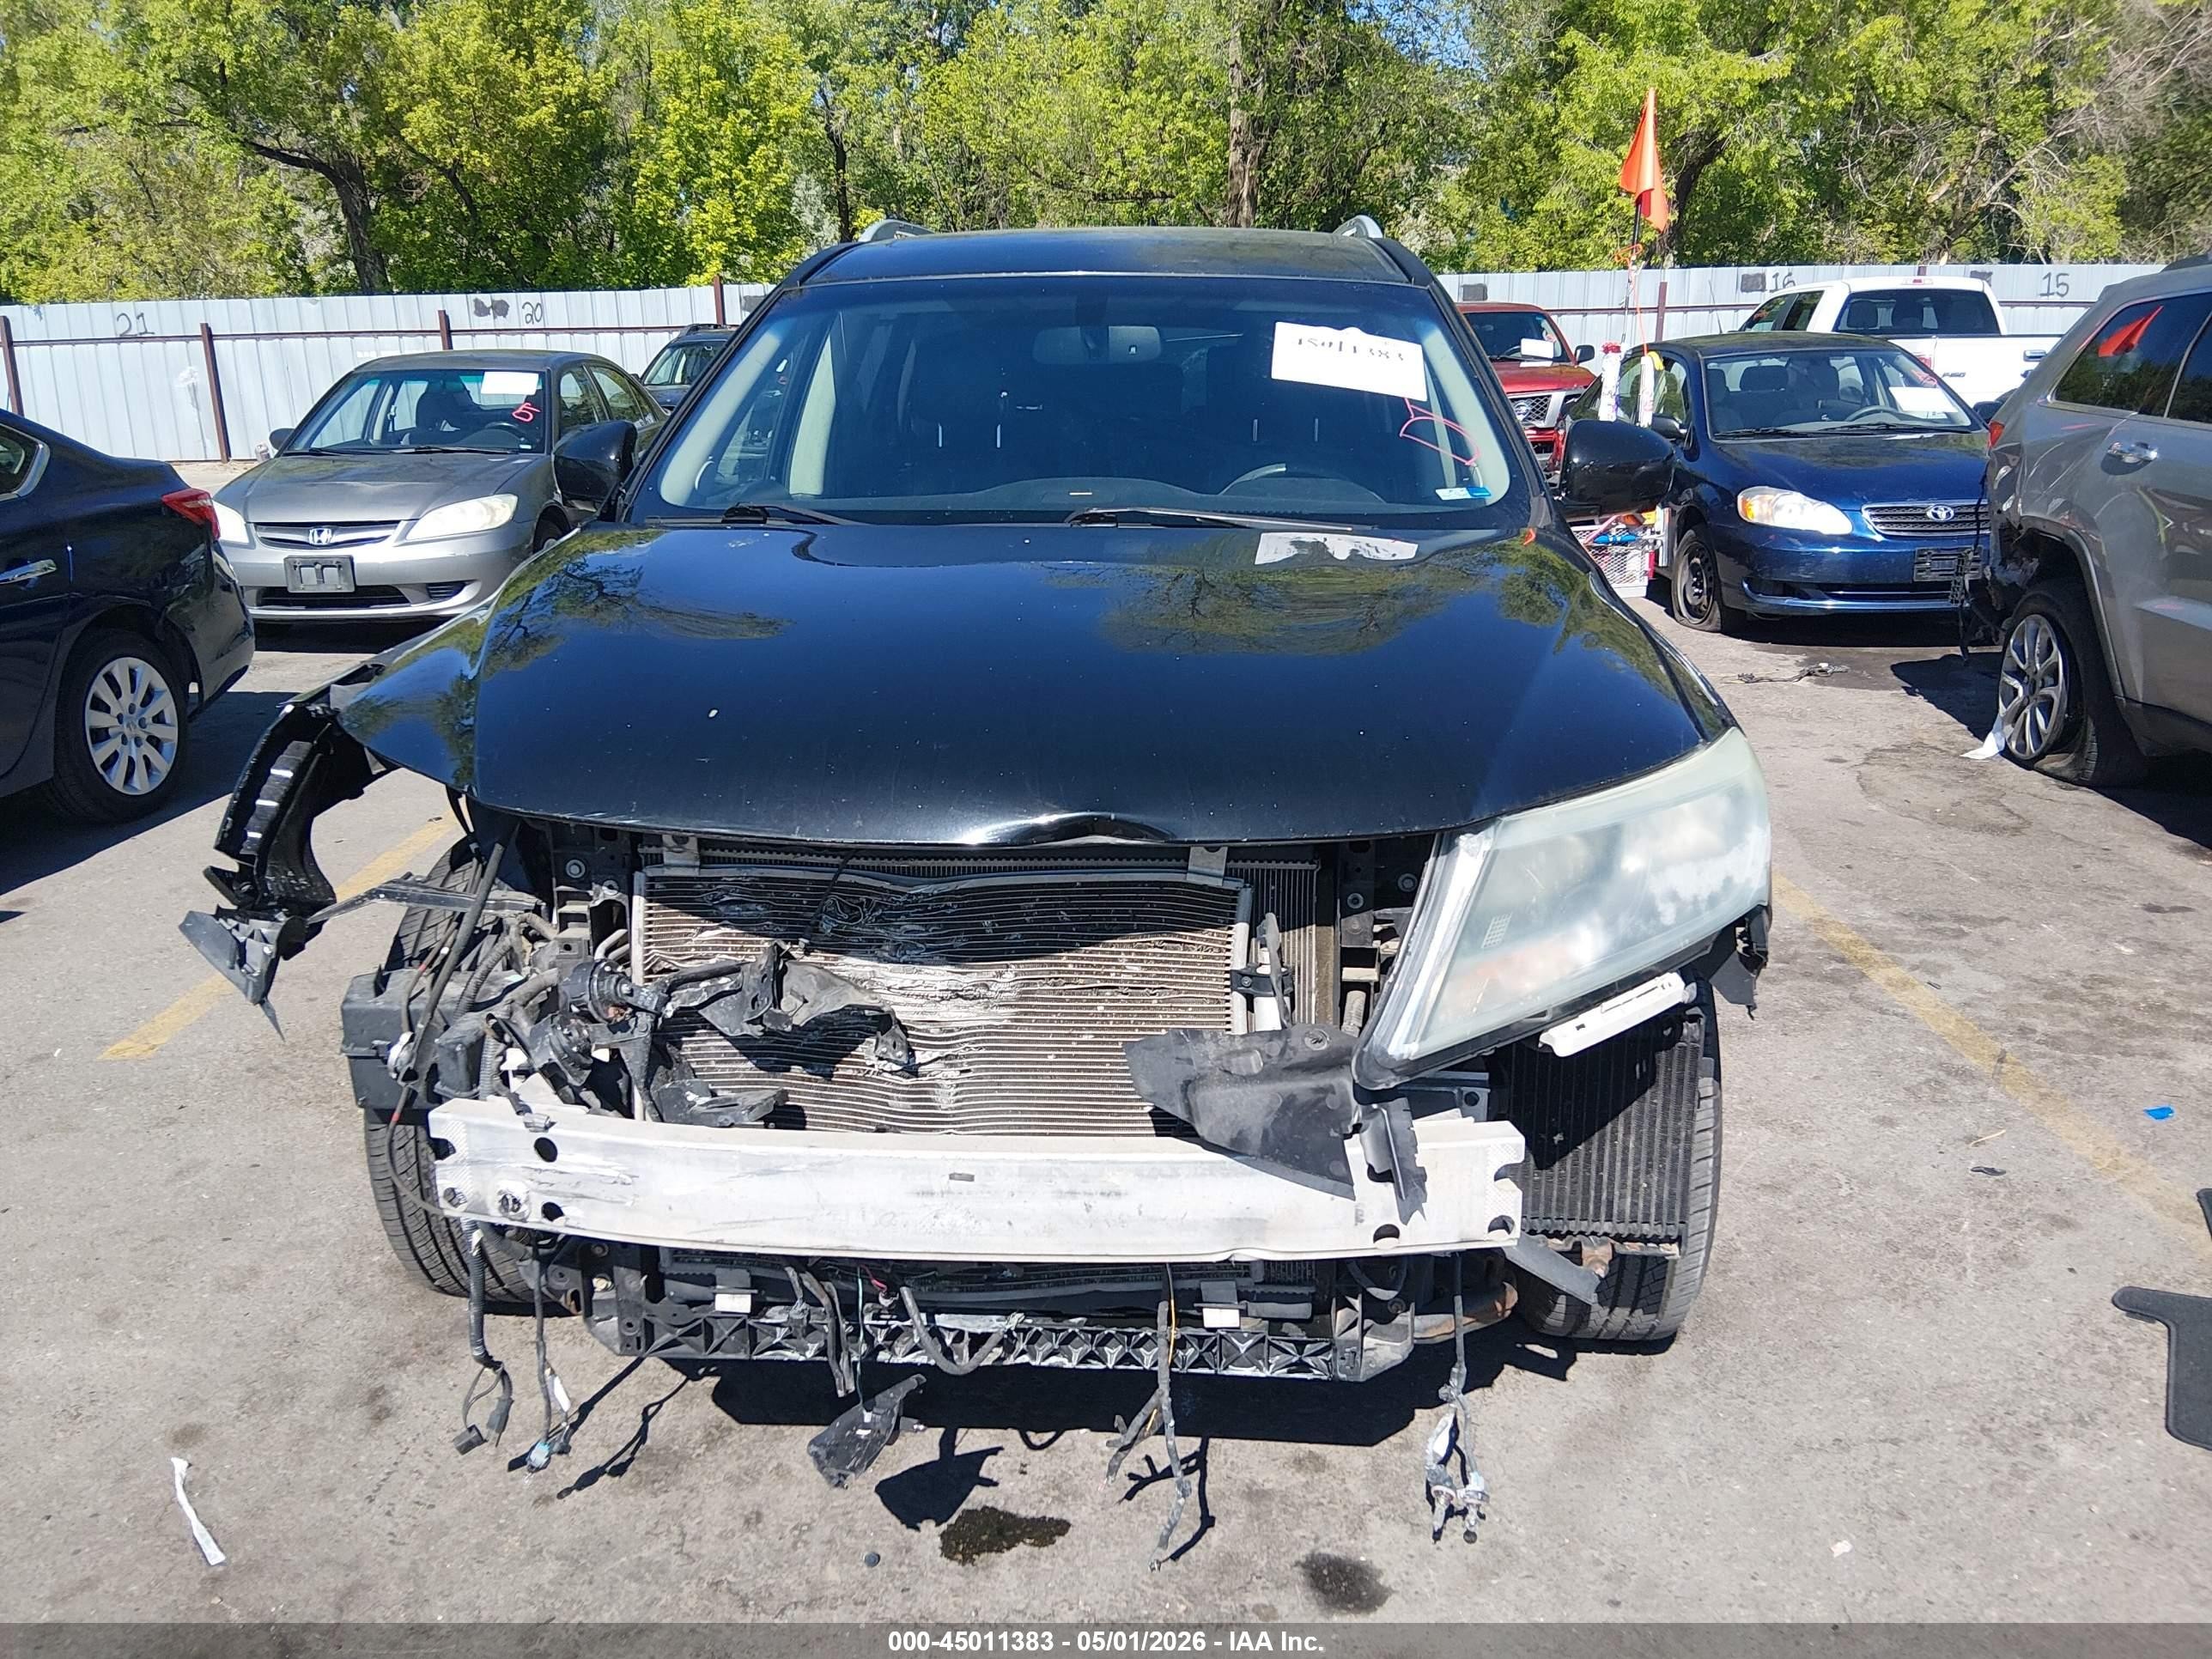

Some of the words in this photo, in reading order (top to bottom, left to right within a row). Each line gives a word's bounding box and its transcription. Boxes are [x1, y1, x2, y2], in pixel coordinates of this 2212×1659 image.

[1769, 271, 1796, 293] 16
[2039, 271, 2070, 298] 15
[116, 313, 155, 337] 21
[521, 301, 544, 325] 20
